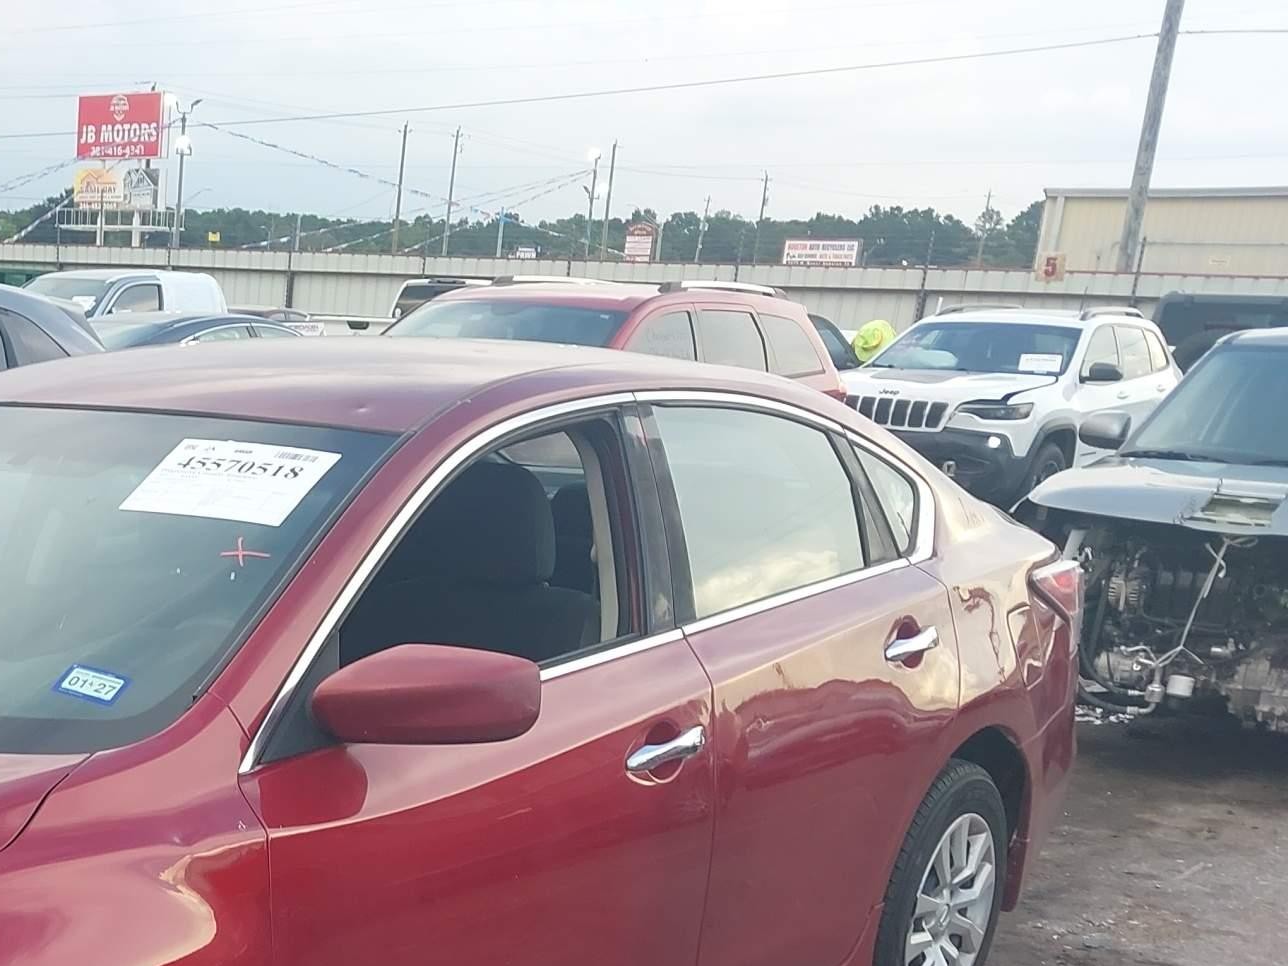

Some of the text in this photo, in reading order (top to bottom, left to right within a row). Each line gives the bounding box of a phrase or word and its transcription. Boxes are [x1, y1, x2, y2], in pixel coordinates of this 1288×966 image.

[80, 122, 158, 144] JB MOTORS
[1044, 256, 1058, 278] 5
[878, 388, 901, 396] Jeep
[177, 456, 304, 479] 45570518
